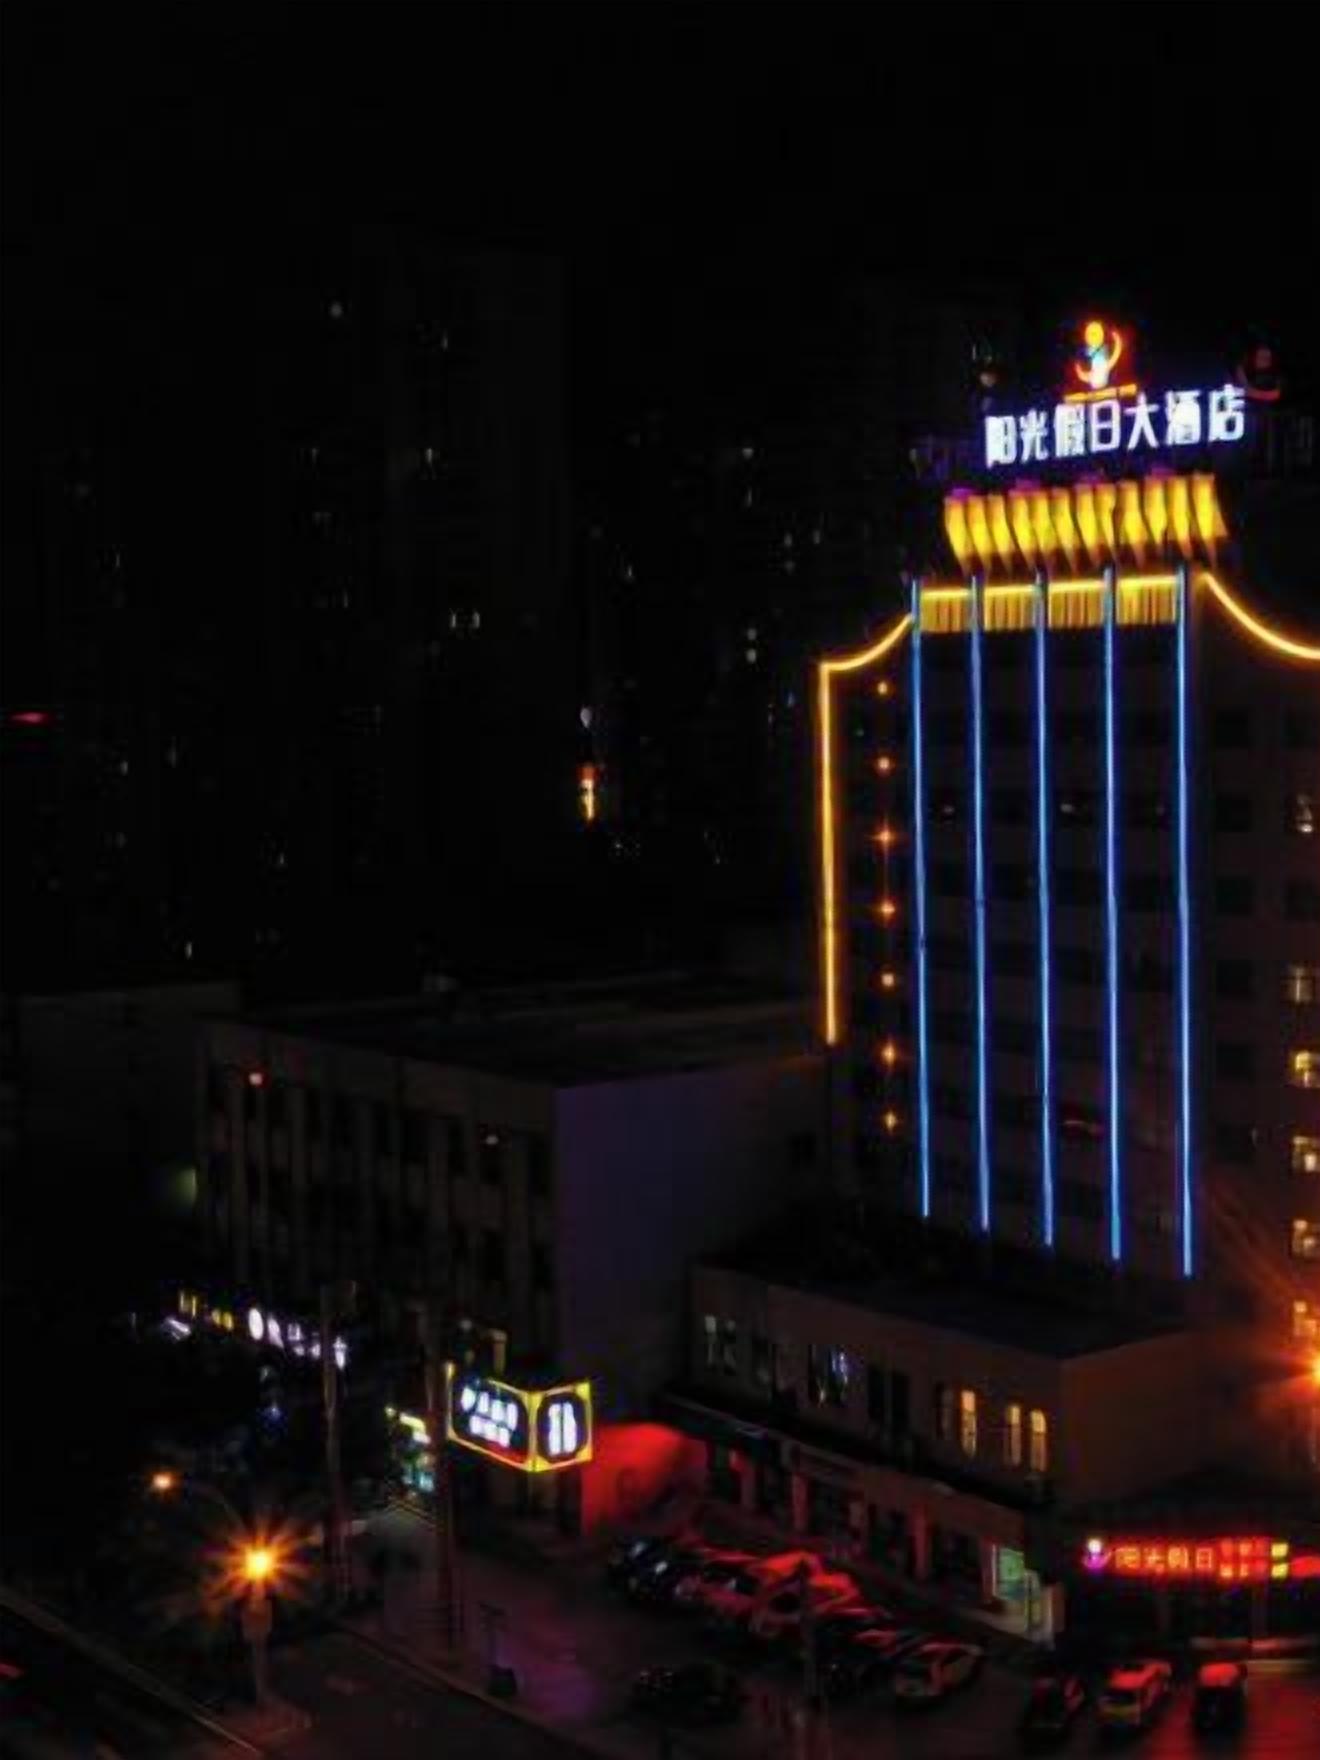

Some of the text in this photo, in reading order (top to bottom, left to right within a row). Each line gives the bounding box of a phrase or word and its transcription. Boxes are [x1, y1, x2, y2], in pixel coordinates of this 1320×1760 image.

[985, 383, 1246, 467] 阳光假日大酒店
